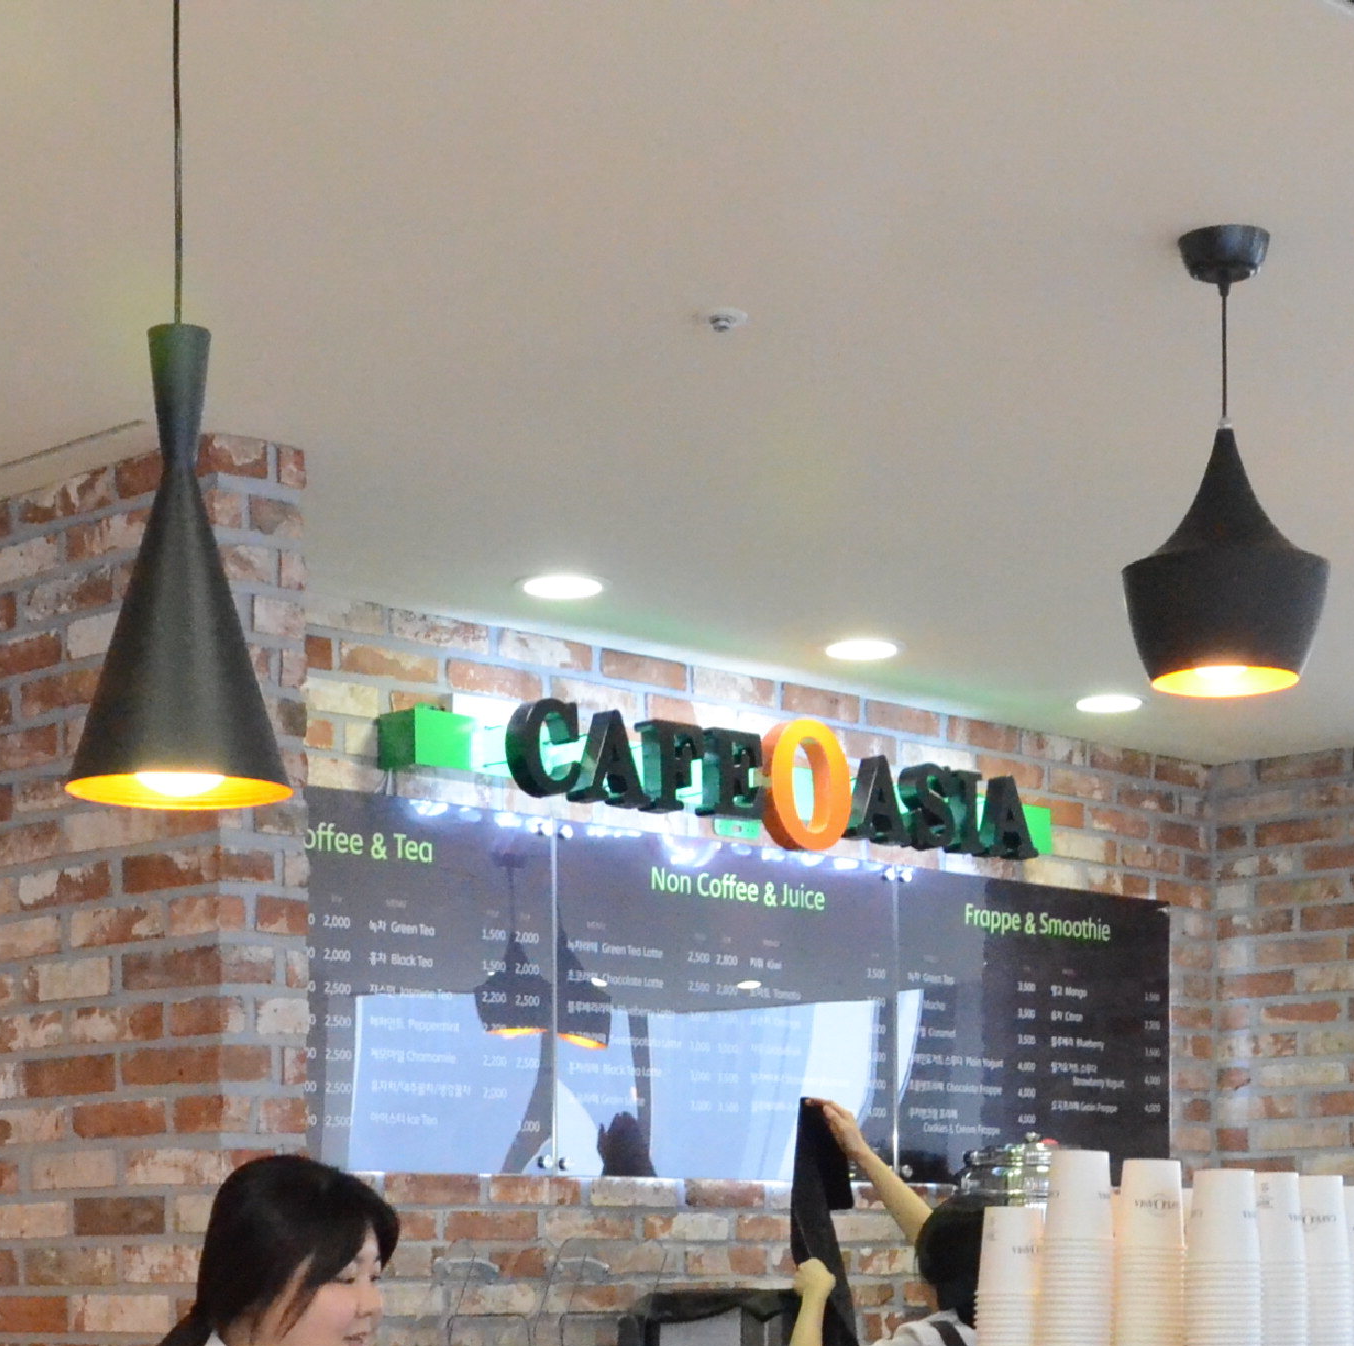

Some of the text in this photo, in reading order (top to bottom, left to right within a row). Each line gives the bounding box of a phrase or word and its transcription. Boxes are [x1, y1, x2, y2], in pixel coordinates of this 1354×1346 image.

[305, 822, 433, 863] offee & Tea
[650, 866, 826, 912] Non Coffee & Juice
[322, 914, 351, 930] 2,000
[964, 903, 1112, 942] Frappe & Smoothie
[391, 921, 418, 935] Green
[419, 923, 435, 936] Tea
[481, 928, 507, 942] 1,500
[515, 931, 540, 944] 2,000
[322, 948, 351, 963] 2,000
[602, 943, 627, 956] Green
[627, 945, 642, 957] Tea
[391, 953, 417, 967] Black
[417, 955, 433, 968] Tea
[515, 963, 540, 976] 2,000
[324, 982, 352, 996] 2,500
[515, 994, 540, 1007] 2,500
